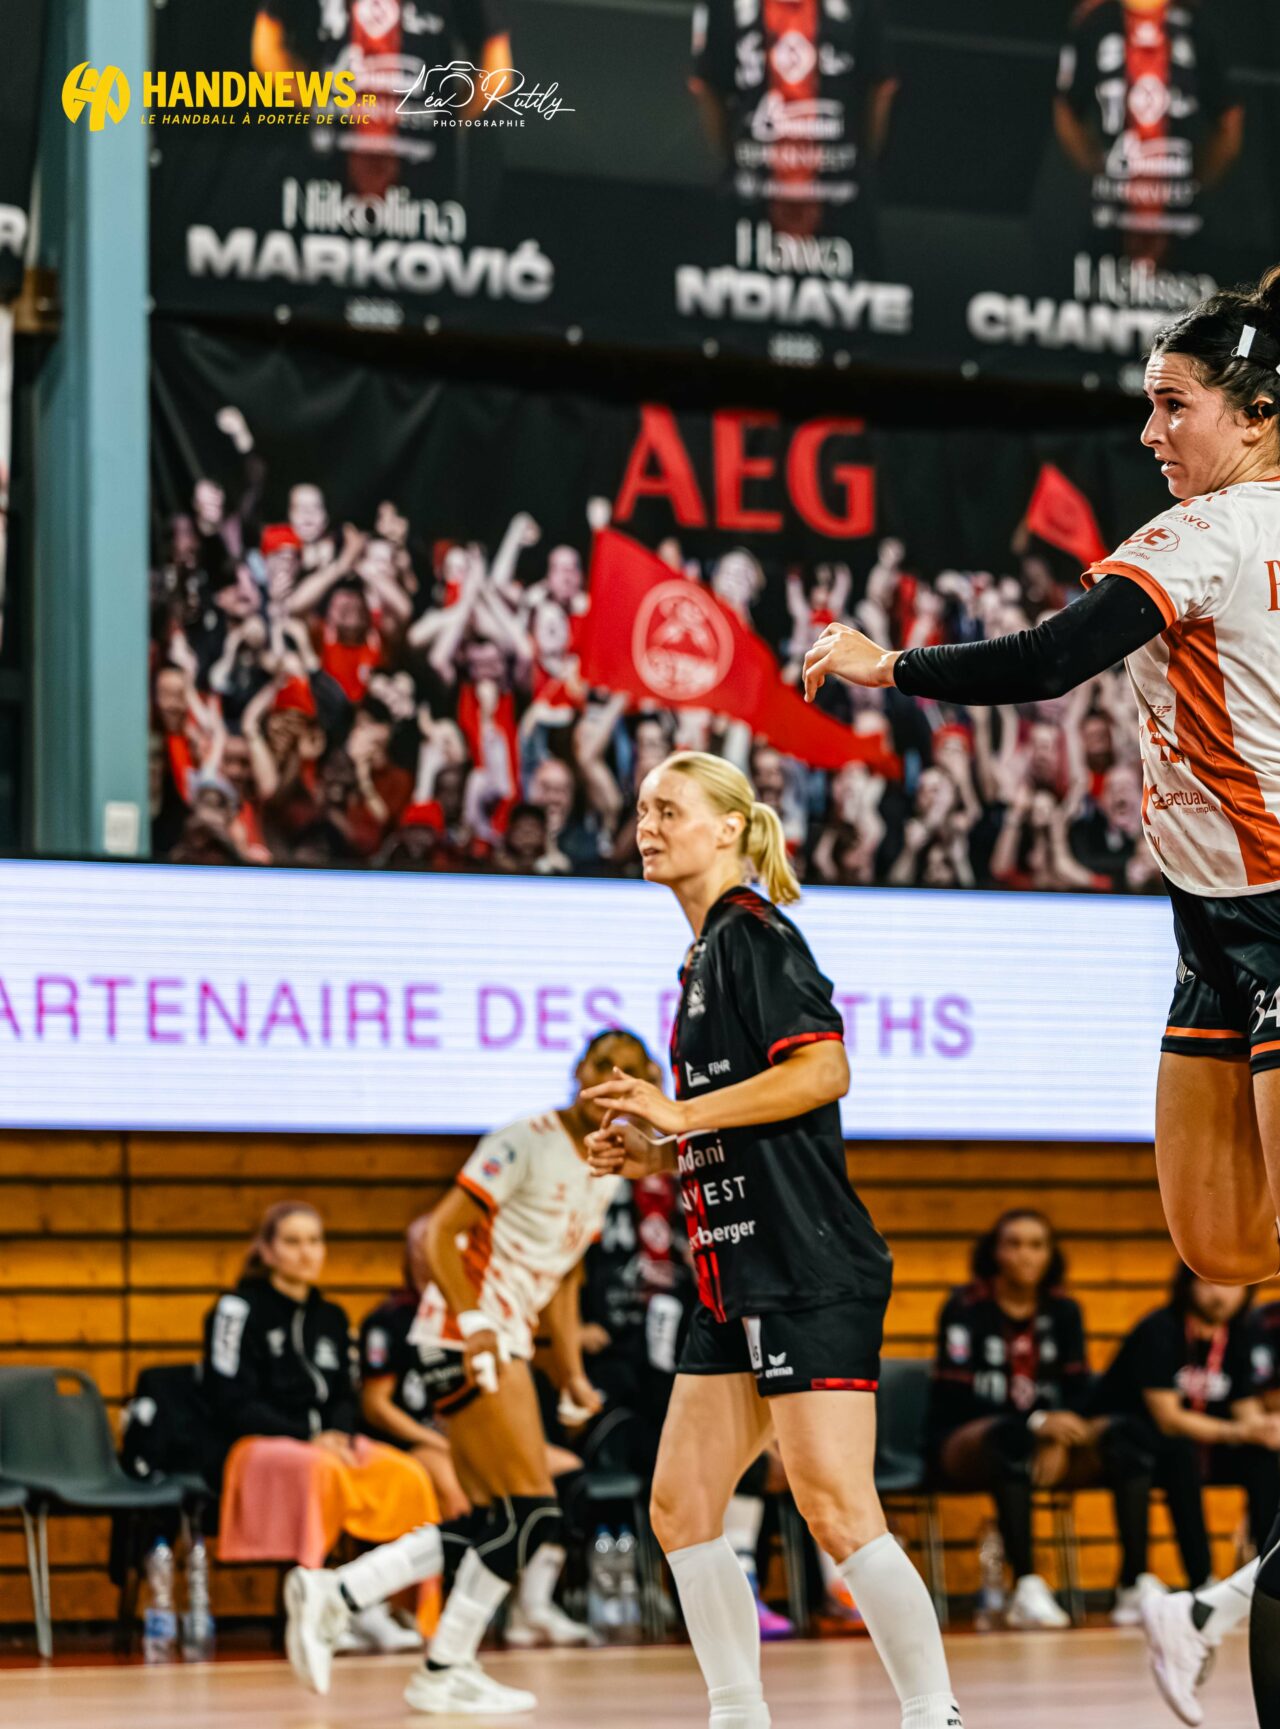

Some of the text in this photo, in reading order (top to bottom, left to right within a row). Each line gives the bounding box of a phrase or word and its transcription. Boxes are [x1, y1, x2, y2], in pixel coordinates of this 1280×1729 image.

[186, 224, 554, 303] MARKOVIĆ
[614, 403, 877, 539] AEG
[473, 982, 628, 1050] DES
